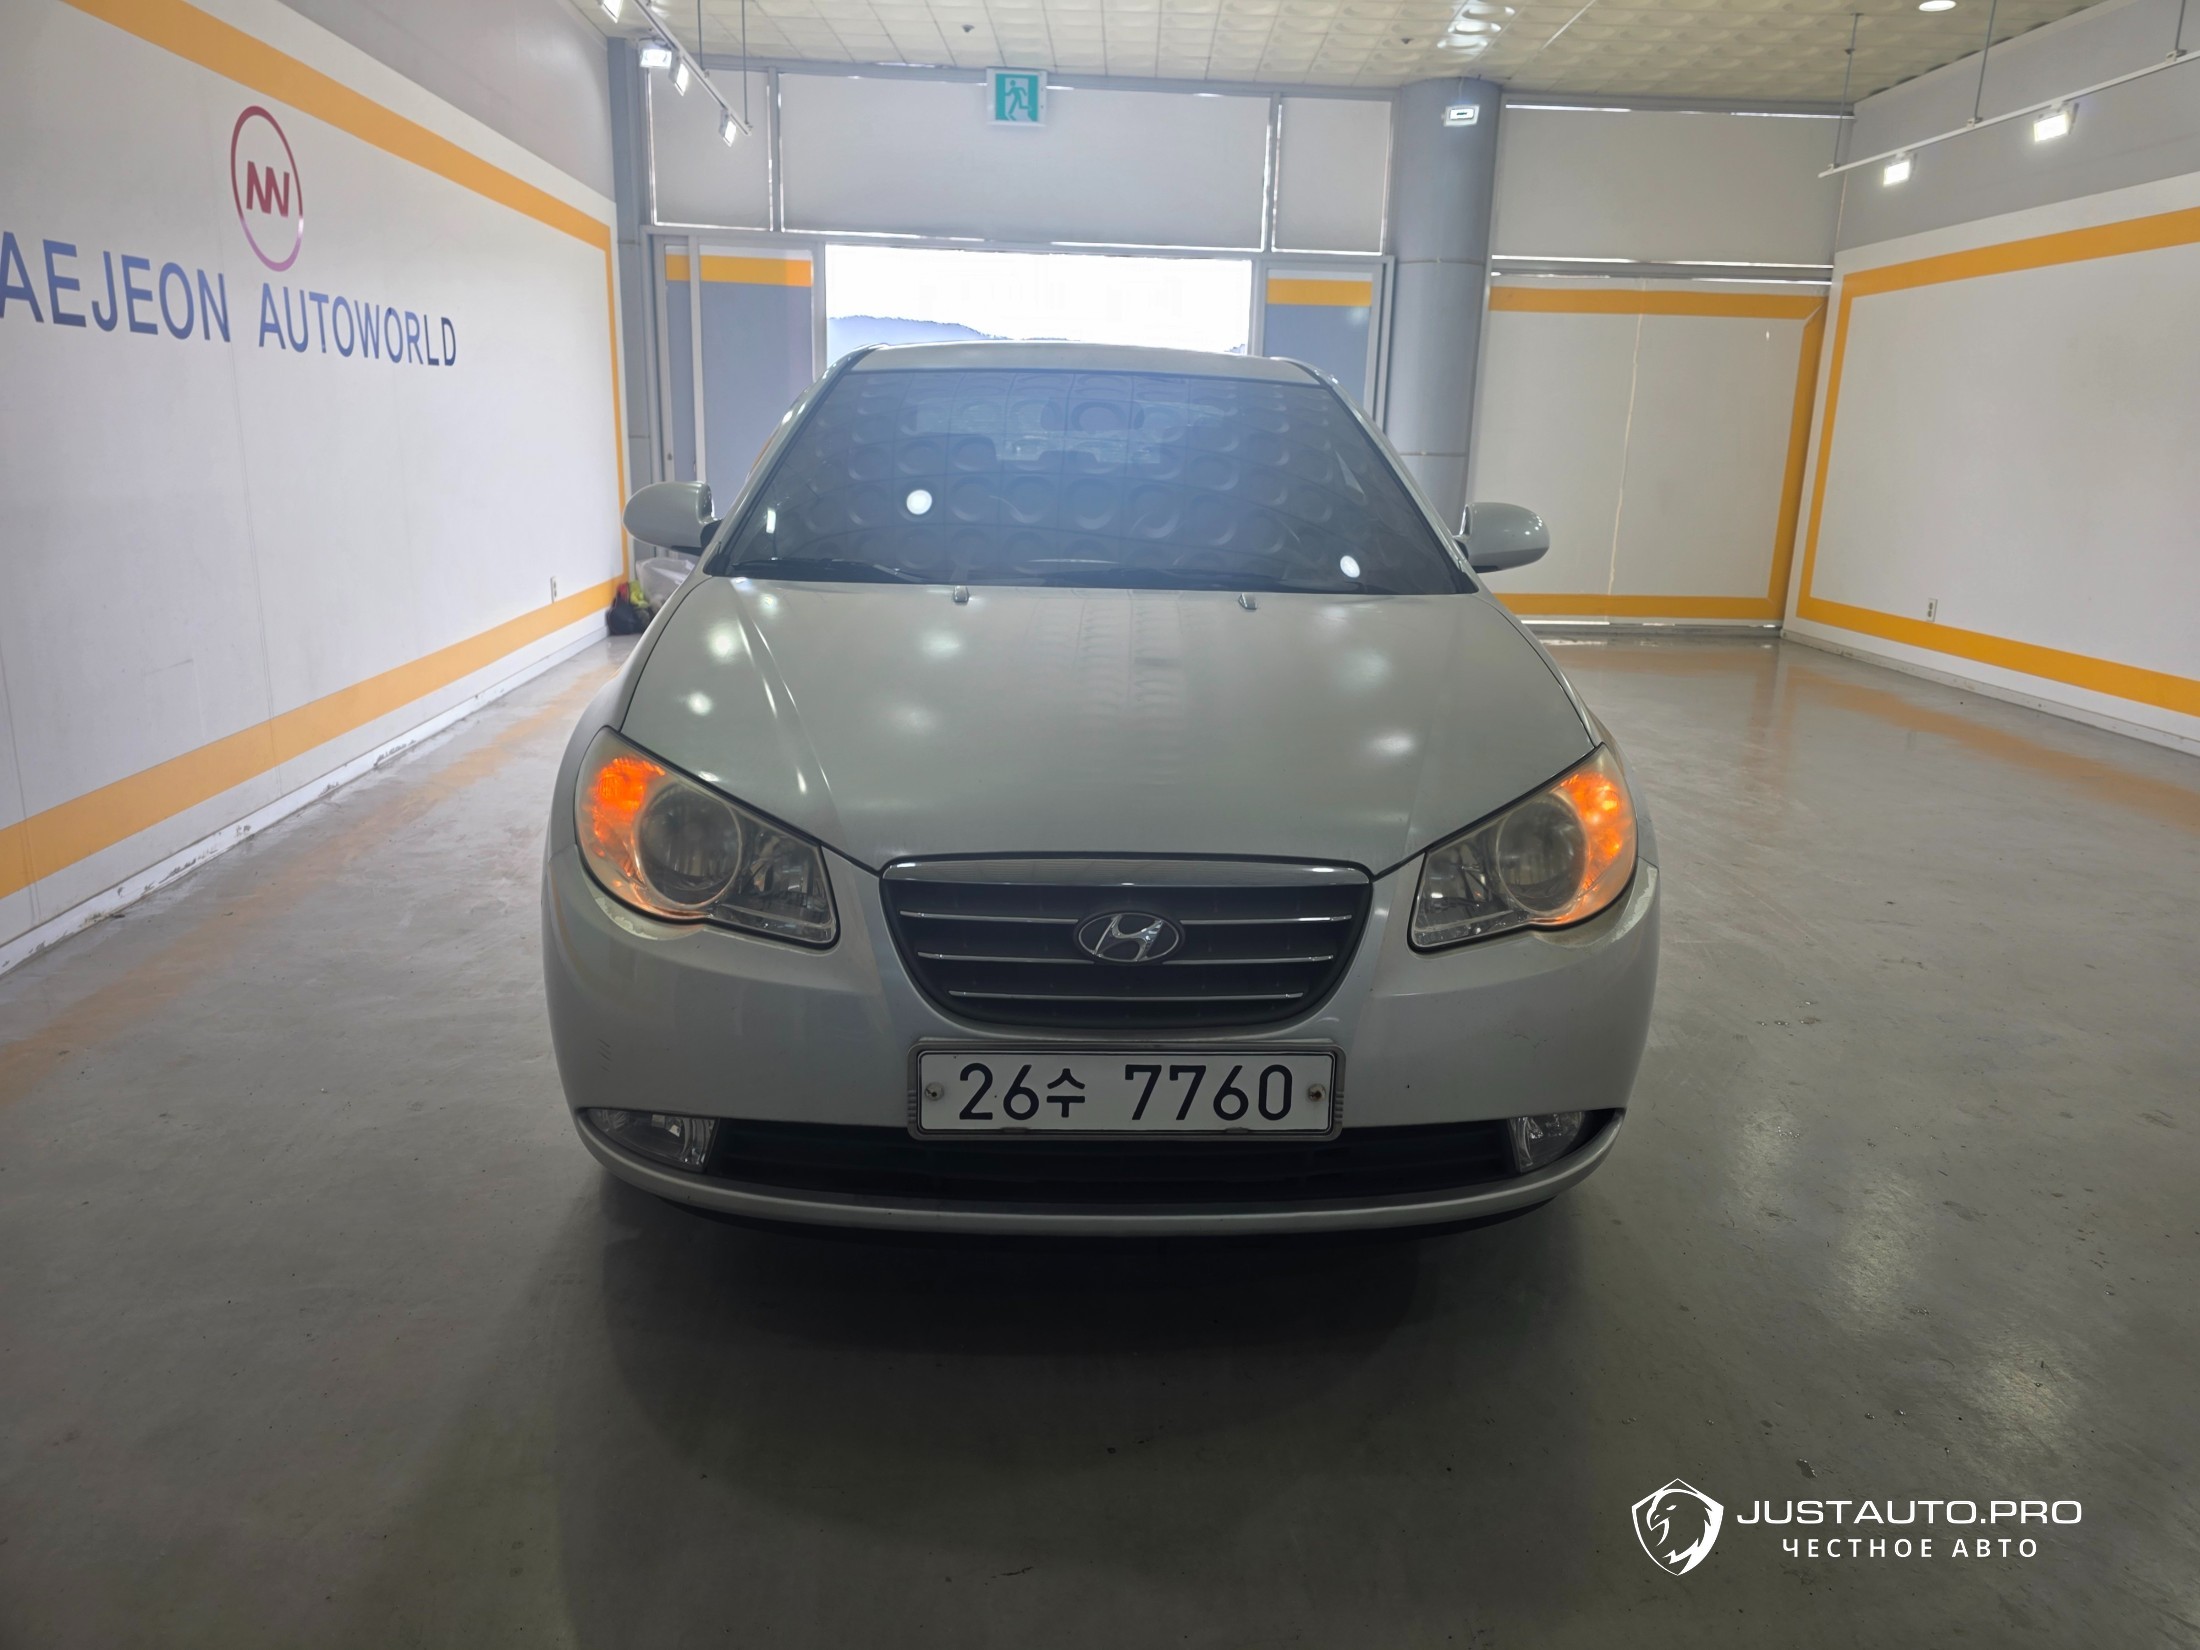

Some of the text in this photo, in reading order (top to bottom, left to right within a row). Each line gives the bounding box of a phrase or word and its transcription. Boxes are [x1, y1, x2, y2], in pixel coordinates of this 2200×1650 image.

[0, 231, 457, 367] AEJEON AUTOWORLD
[959, 1063, 1293, 1121] 26수 7760
